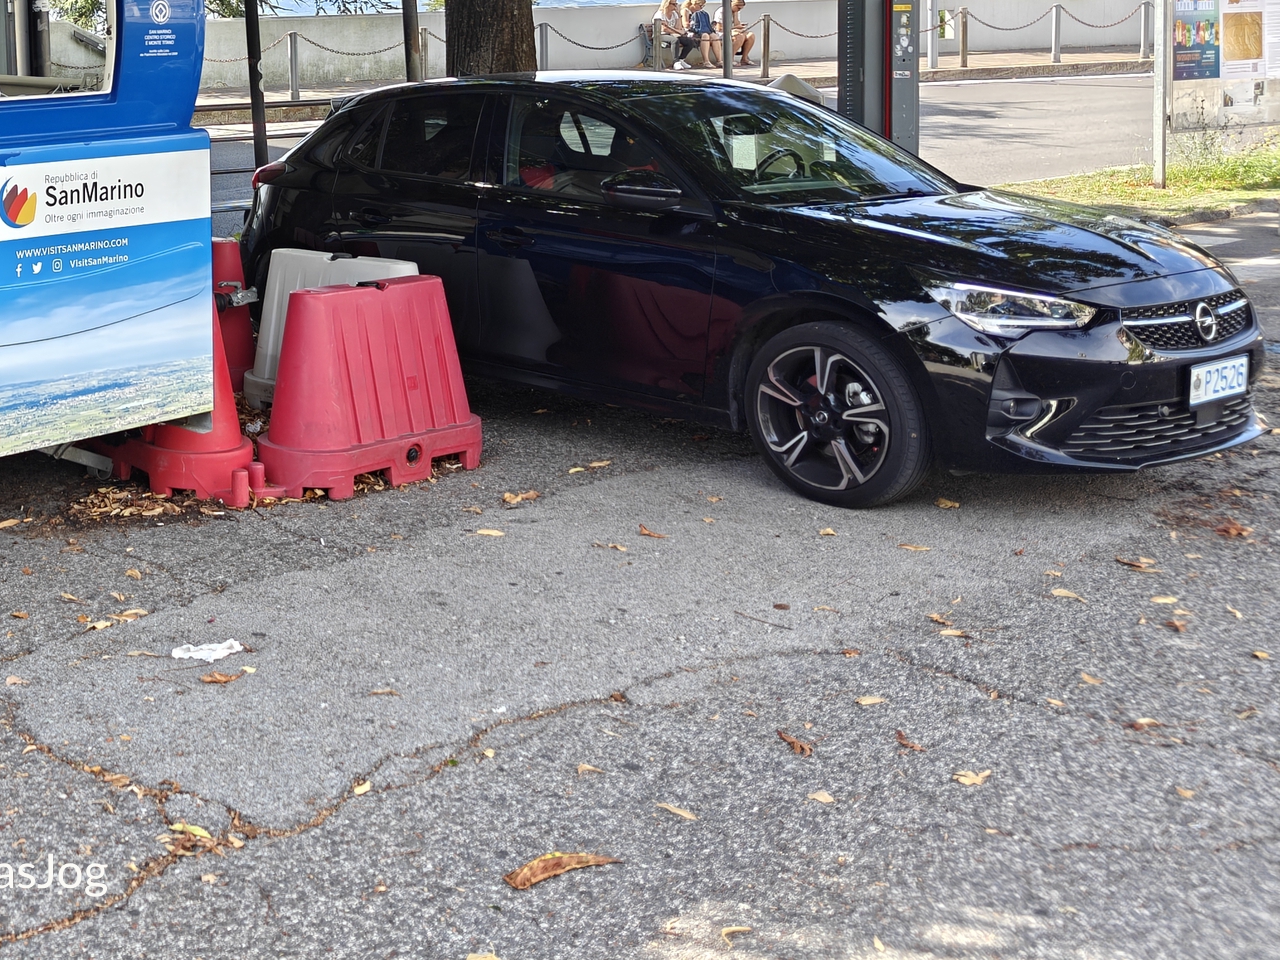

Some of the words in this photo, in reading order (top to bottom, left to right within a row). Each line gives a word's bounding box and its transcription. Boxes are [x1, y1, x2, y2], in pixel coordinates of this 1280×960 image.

[44, 172, 88, 186] Repubblica
[91, 170, 98, 180] di
[45, 179, 144, 206] SanMarino
[44, 214, 64, 224] Oltre
[66, 211, 84, 222] ogni
[86, 206, 145, 220] immaginazione
[16, 238, 128, 259] WWW.VISITSANMARINO.COM
[70, 253, 128, 268] VisitSanMarino
[1204, 363, 1244, 396] P2526
